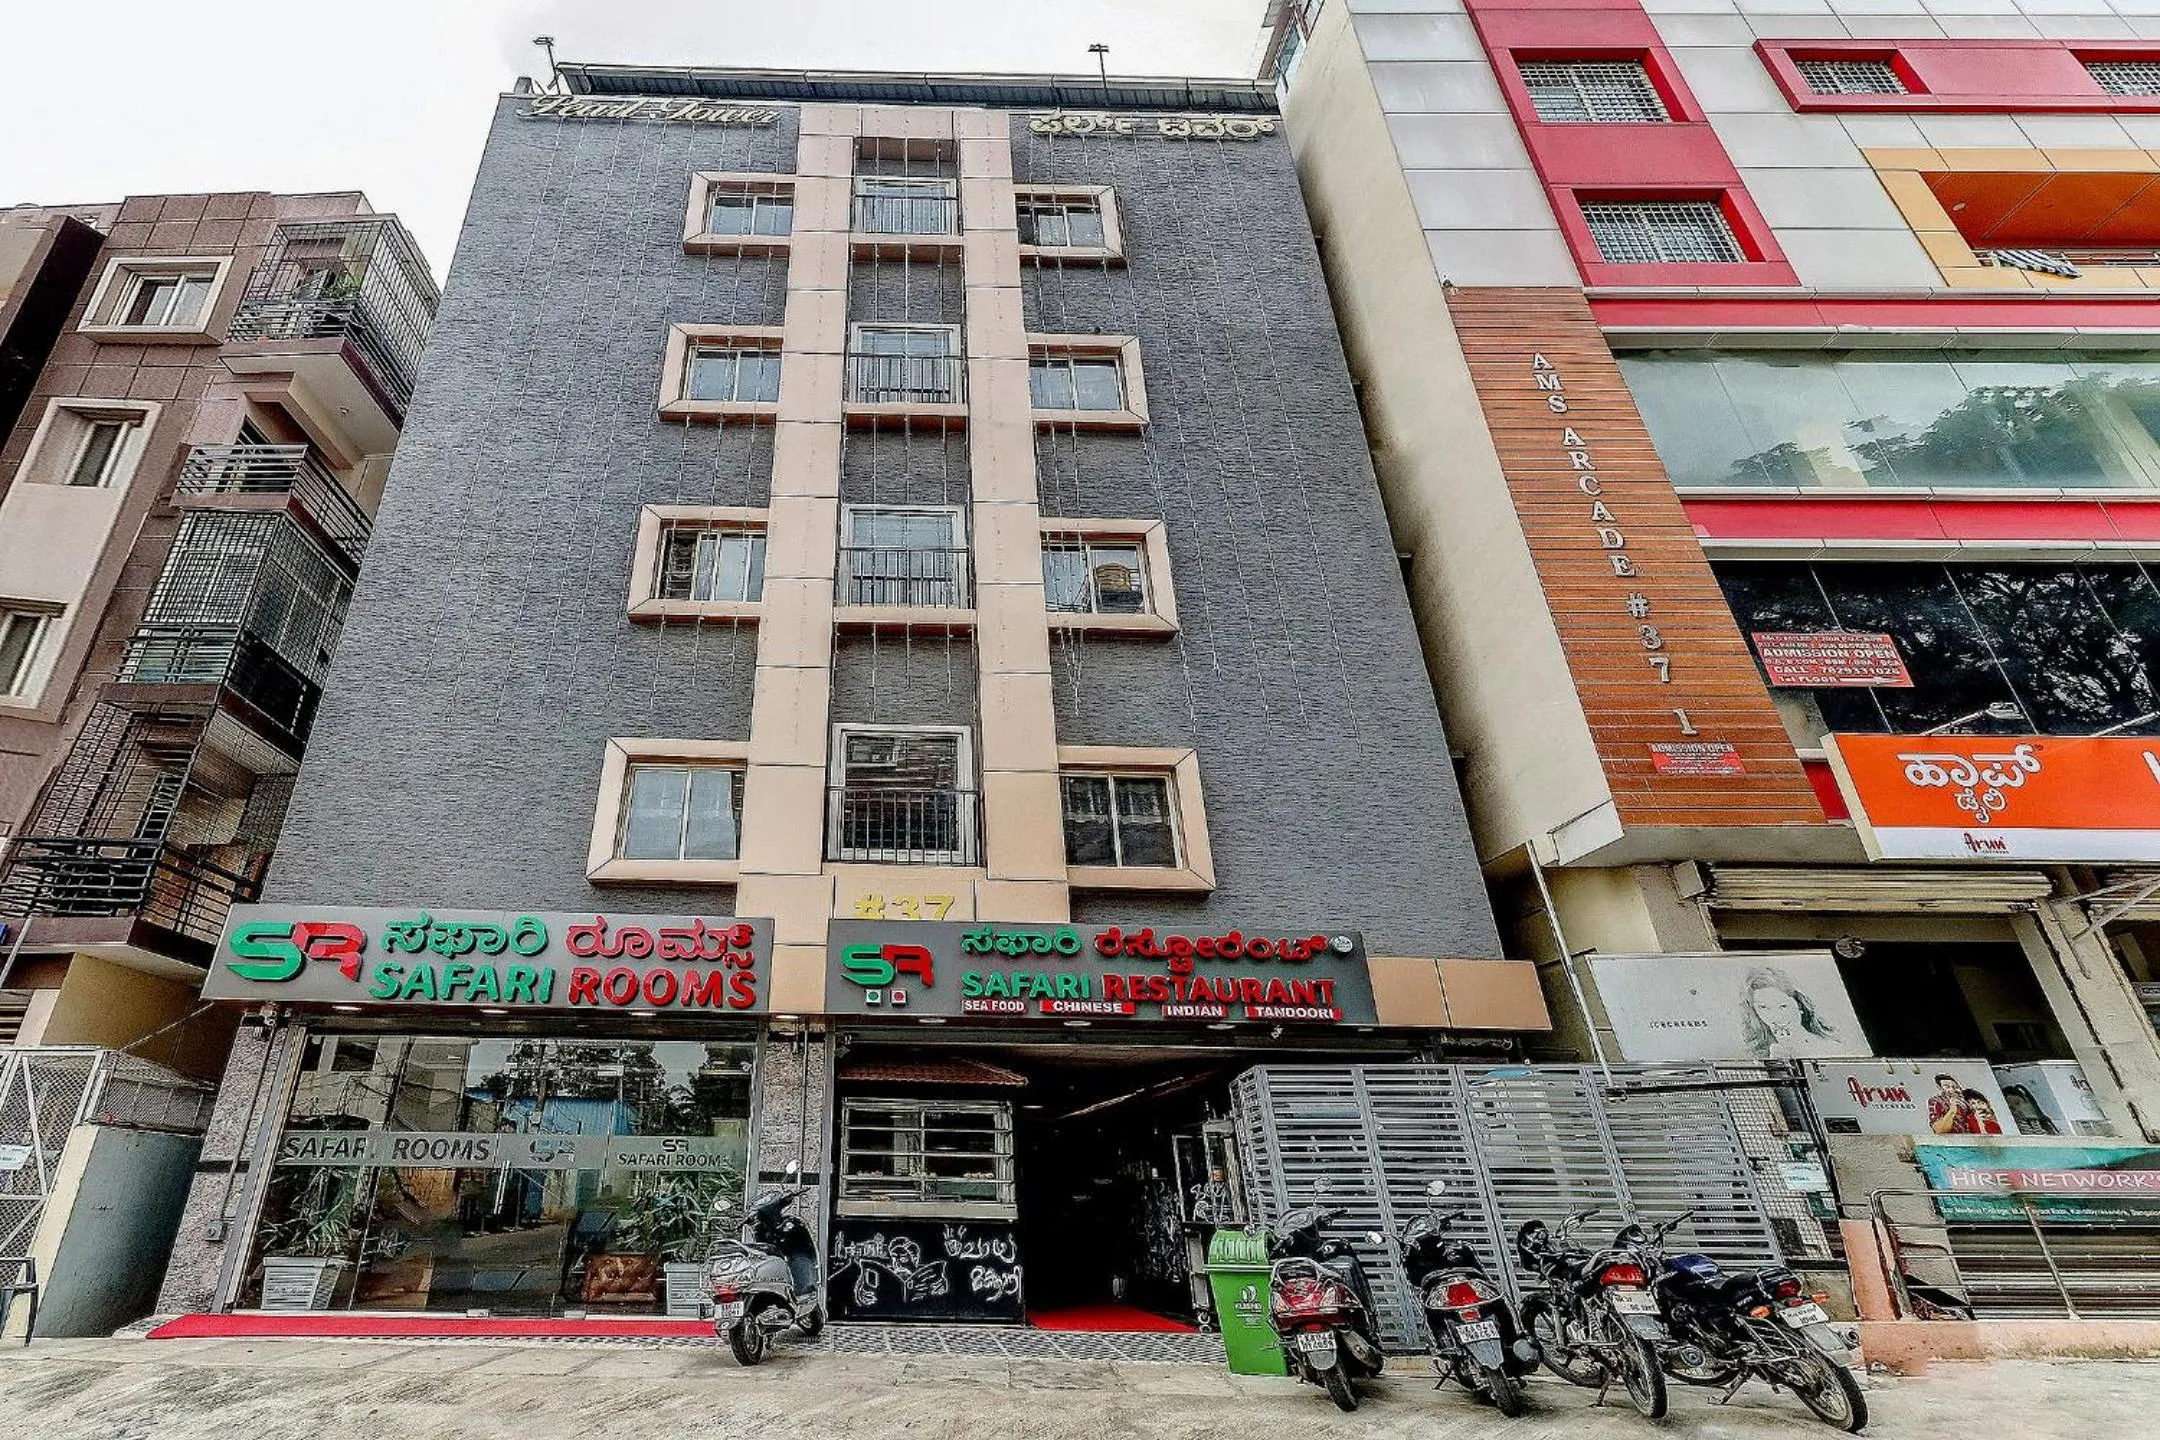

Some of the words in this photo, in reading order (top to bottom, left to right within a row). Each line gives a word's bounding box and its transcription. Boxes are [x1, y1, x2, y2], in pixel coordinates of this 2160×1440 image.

[519, 96, 648, 117] Pearl
[661, 99, 782, 123] Tower
[1531, 352, 1568, 413] AMS
[1561, 427, 1637, 577] ARCADE
[1763, 648, 1849, 658] ADMISSION
[1854, 649, 1897, 659] OPEN
[1774, 666, 1809, 674] CALL
[853, 893, 956, 920] #37
[379, 911, 549, 959] ಸಫಾರಿ
[960, 924, 1083, 957] ಸಫಾರಿ
[224, 920, 367, 982] SR
[840, 943, 935, 988] SR
[369, 960, 556, 1004] SAFARI
[567, 966, 758, 1010] ROOMS
[960, 970, 1091, 1000] SAFARI
[1101, 973, 1337, 1005] RESTAURANT
[964, 1000, 988, 1012] SEA
[991, 1000, 1025, 1012] FOOD
[1053, 1001, 1123, 1013] CHINESE
[1167, 1004, 1223, 1017] INDIAN
[1256, 1006, 1335, 1020] TANDOORI
[282, 1136, 378, 1160] SAFAR
[391, 1138, 491, 1161] ROOMS
[618, 1153, 671, 1166] SAFARI
